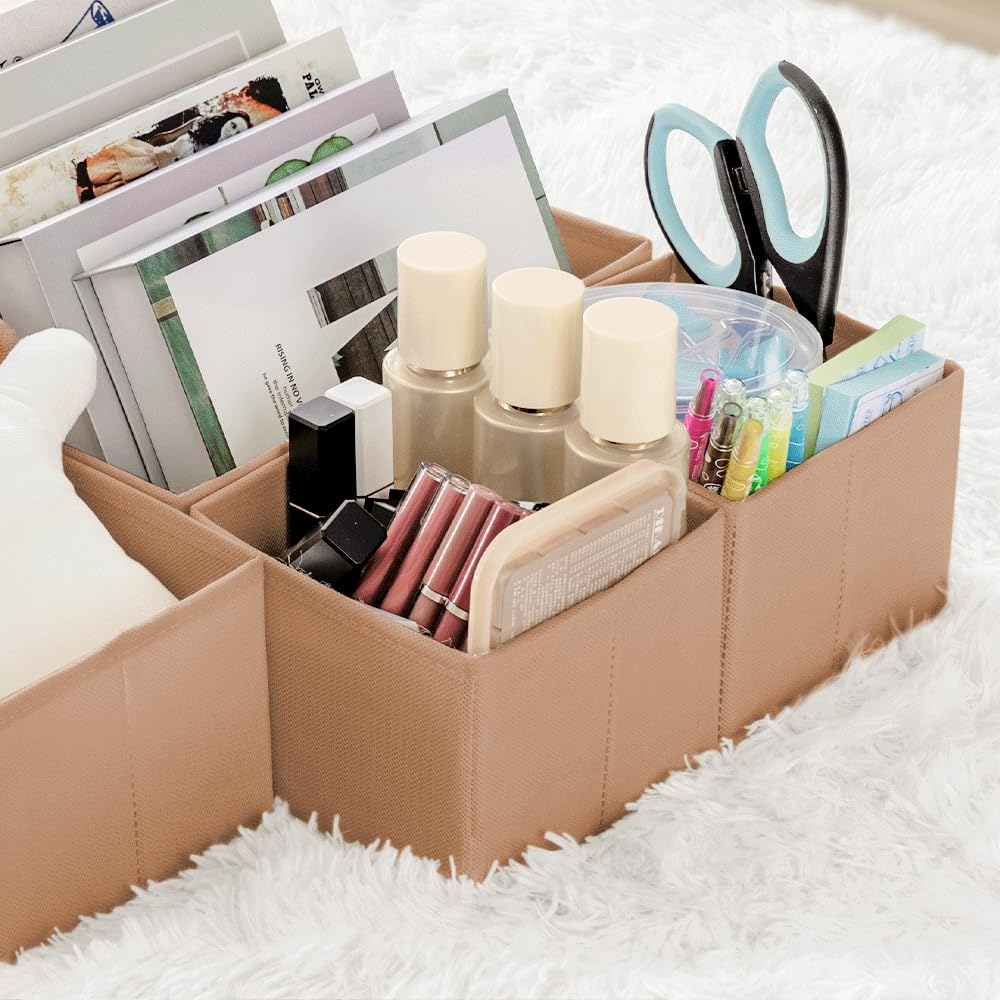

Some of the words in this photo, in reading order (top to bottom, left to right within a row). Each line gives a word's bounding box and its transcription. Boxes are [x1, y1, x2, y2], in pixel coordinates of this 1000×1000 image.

[302, 72, 318, 99] PAL
[275, 343, 291, 372] RISING
[286, 372, 295, 383] IN
[290, 383, 300, 397] NO
